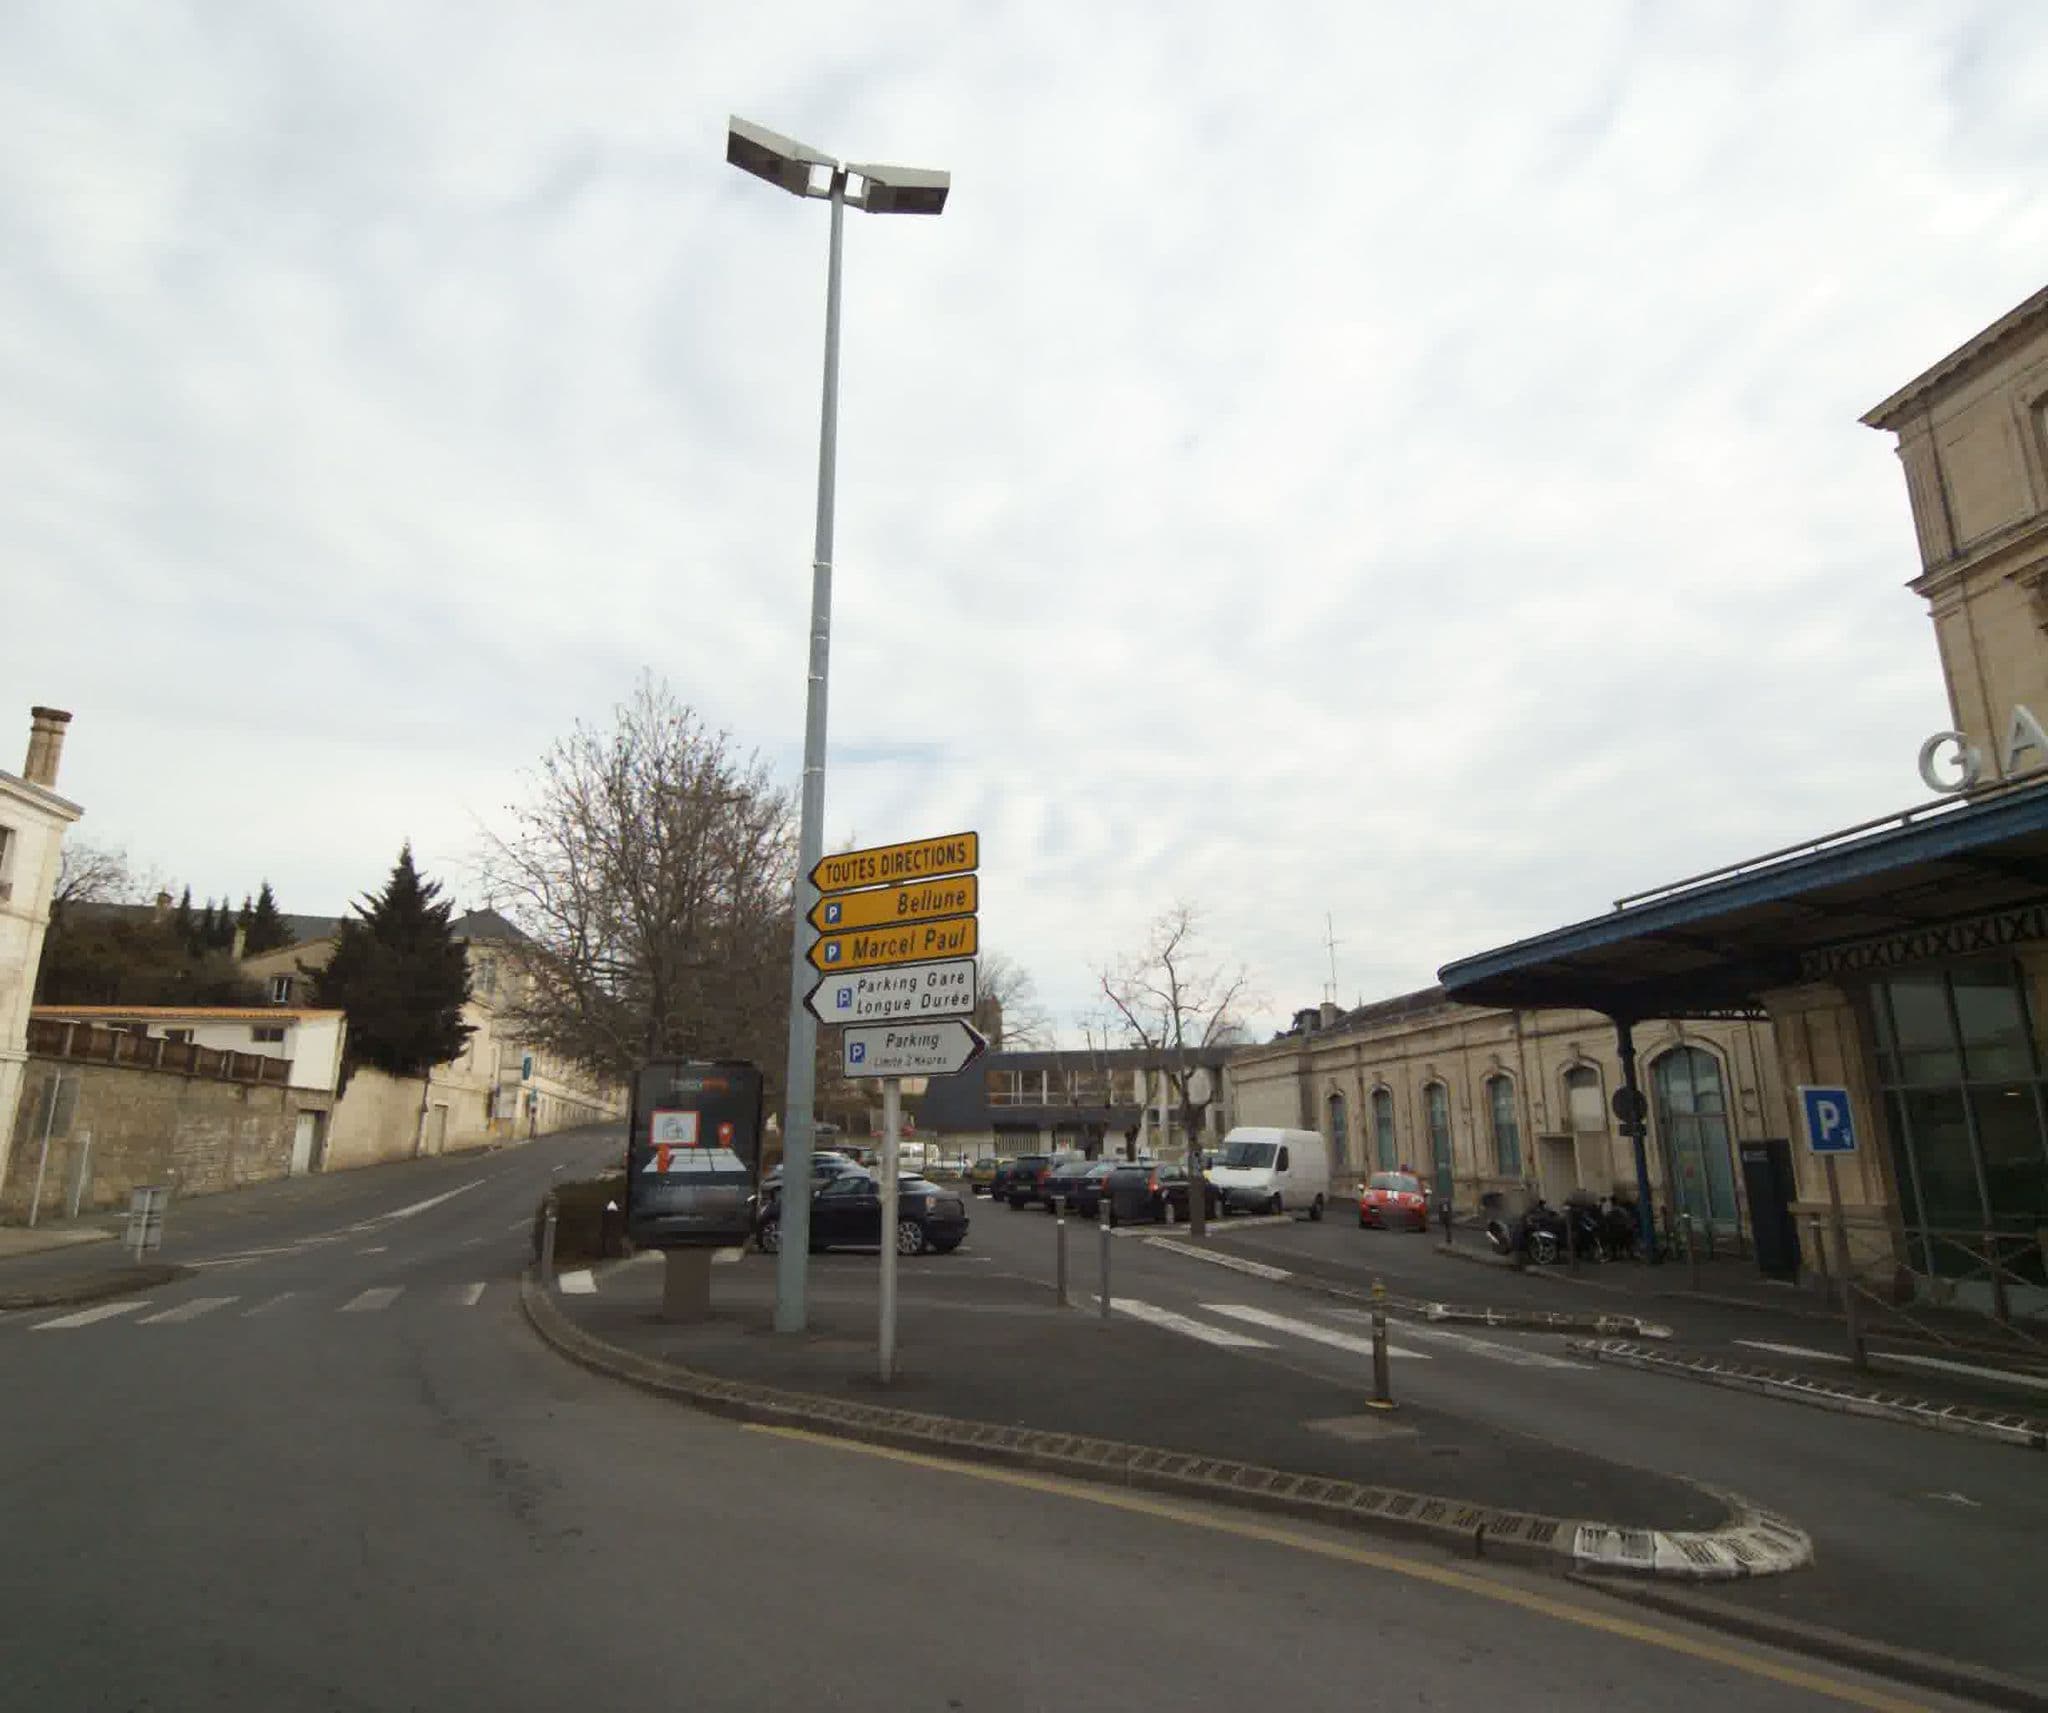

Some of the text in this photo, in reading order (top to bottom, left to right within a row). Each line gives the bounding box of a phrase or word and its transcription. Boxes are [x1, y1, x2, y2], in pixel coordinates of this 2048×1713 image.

[825, 842, 966, 884] TOUTES DIRECTIONS
[829, 889, 966, 921] P Bellune
[829, 926, 966, 960] P Marcel Paul
[857, 971, 965, 992] Parking Gare
[857, 992, 970, 1015] Longue Durée
[853, 1045, 864, 1061] P
[886, 1032, 940, 1050] Parking
[1817, 1100, 1839, 1140] P
